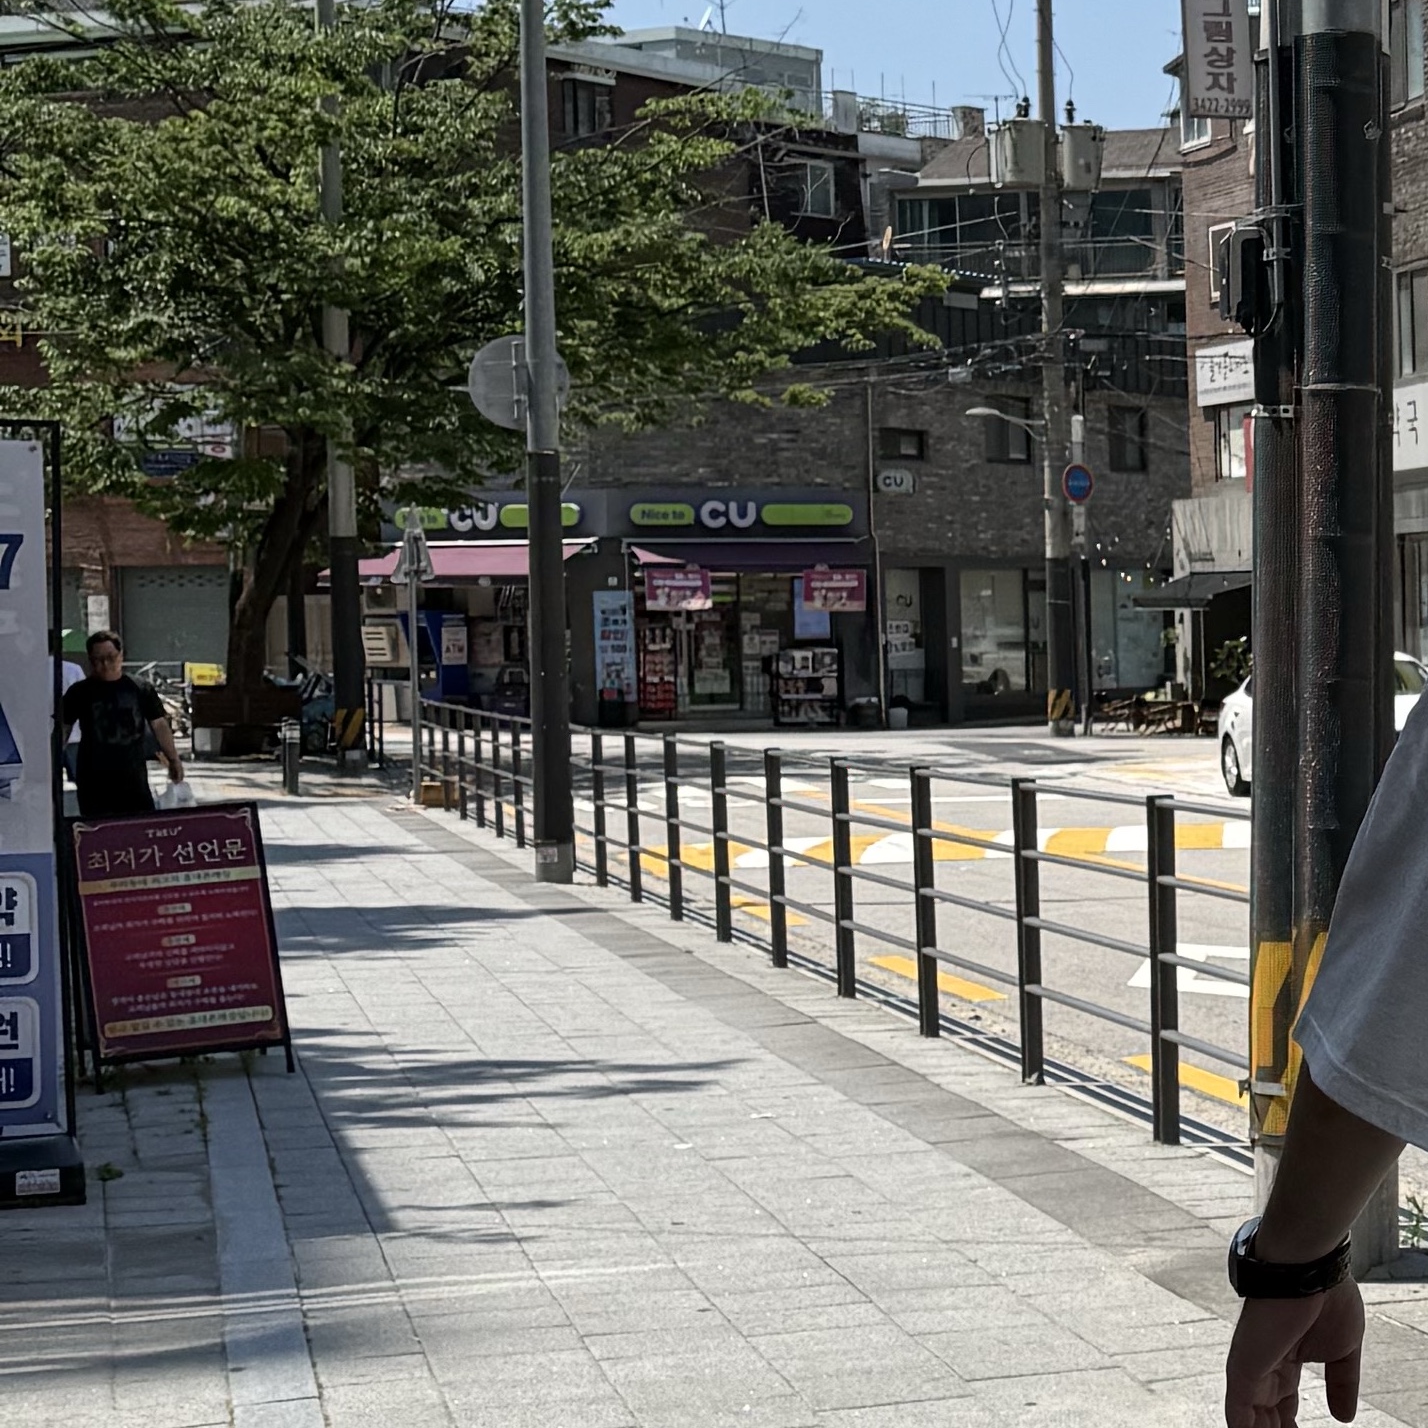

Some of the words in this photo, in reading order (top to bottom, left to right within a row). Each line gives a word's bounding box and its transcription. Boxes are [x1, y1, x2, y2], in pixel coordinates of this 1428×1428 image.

[882, 476, 904, 488] CU
[640, 509, 669, 521] Nice
[701, 500, 757, 529] CU
[87, 844, 163, 872] 최저가
[172, 838, 248, 866] 선언문
